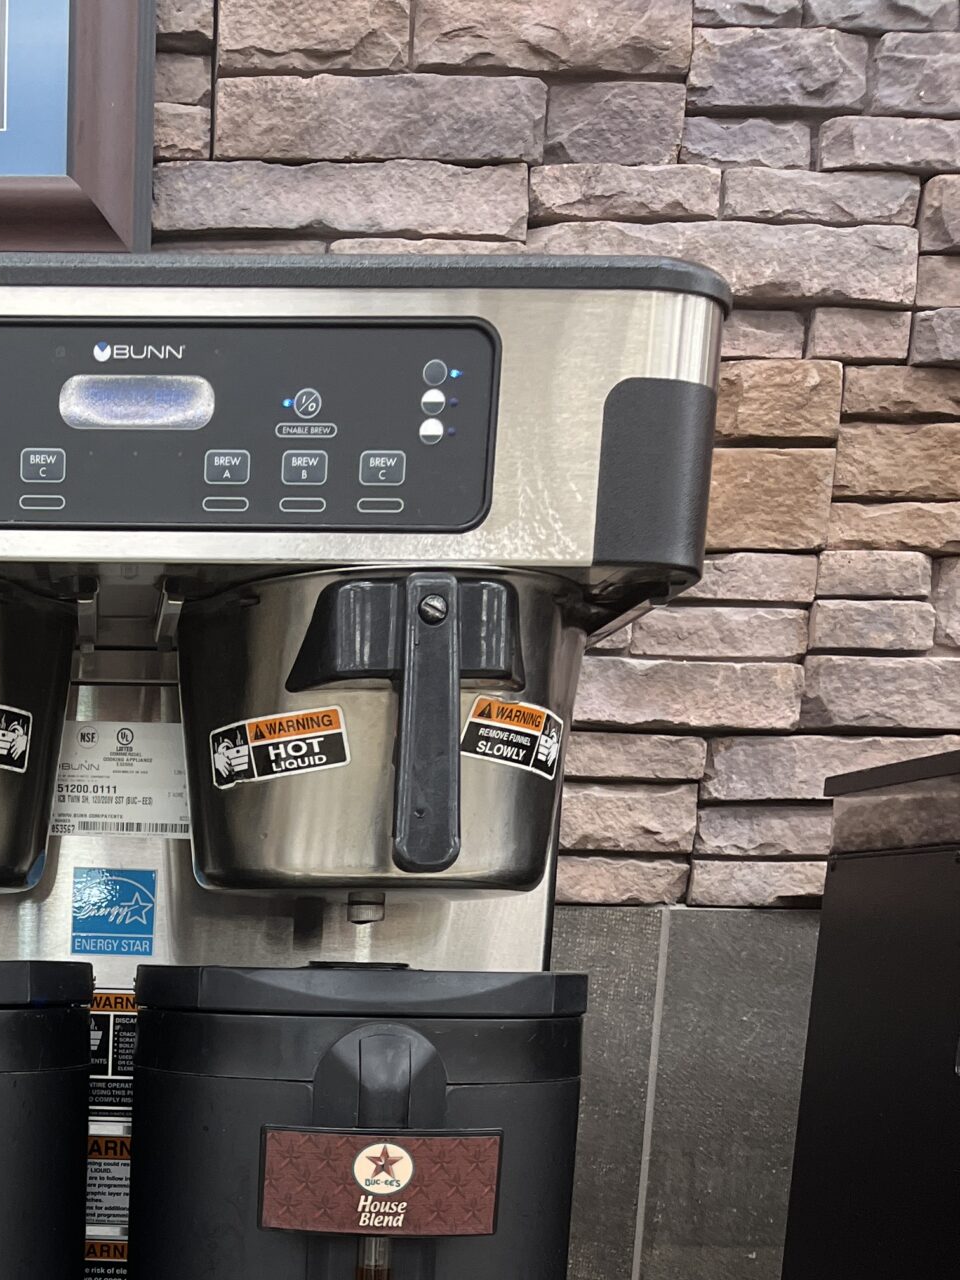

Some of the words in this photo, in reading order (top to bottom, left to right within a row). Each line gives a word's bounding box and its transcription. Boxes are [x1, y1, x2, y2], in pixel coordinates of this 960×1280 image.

[113, 345, 183, 359] BUNN
[282, 426, 309, 434] ENABLE
[310, 426, 331, 434] BREW
[30, 454, 57, 465] BREW
[214, 456, 241, 466] BREW
[292, 456, 319, 467] BREW
[370, 457, 397, 467] BREW
[39, 467, 47, 477] C
[223, 470, 231, 479] A
[301, 470, 308, 480] B
[378, 470, 386, 480] C
[496, 706, 541, 728] WARNING
[266, 714, 333, 736] WARNING
[80, 732, 96, 743] NSF
[478, 727, 509, 740] REMOVE
[509, 733, 531, 746] FUNNEL
[268, 737, 324, 760] HOT
[476, 741, 526, 761] SLOWLY
[61, 762, 100, 771] BUNN
[271, 754, 327, 772] LIQUID
[75, 939, 119, 951] ENERGY
[121, 940, 149, 952] STAR
[357, 1195, 407, 1213] House
[358, 1212, 404, 1227] Blend
